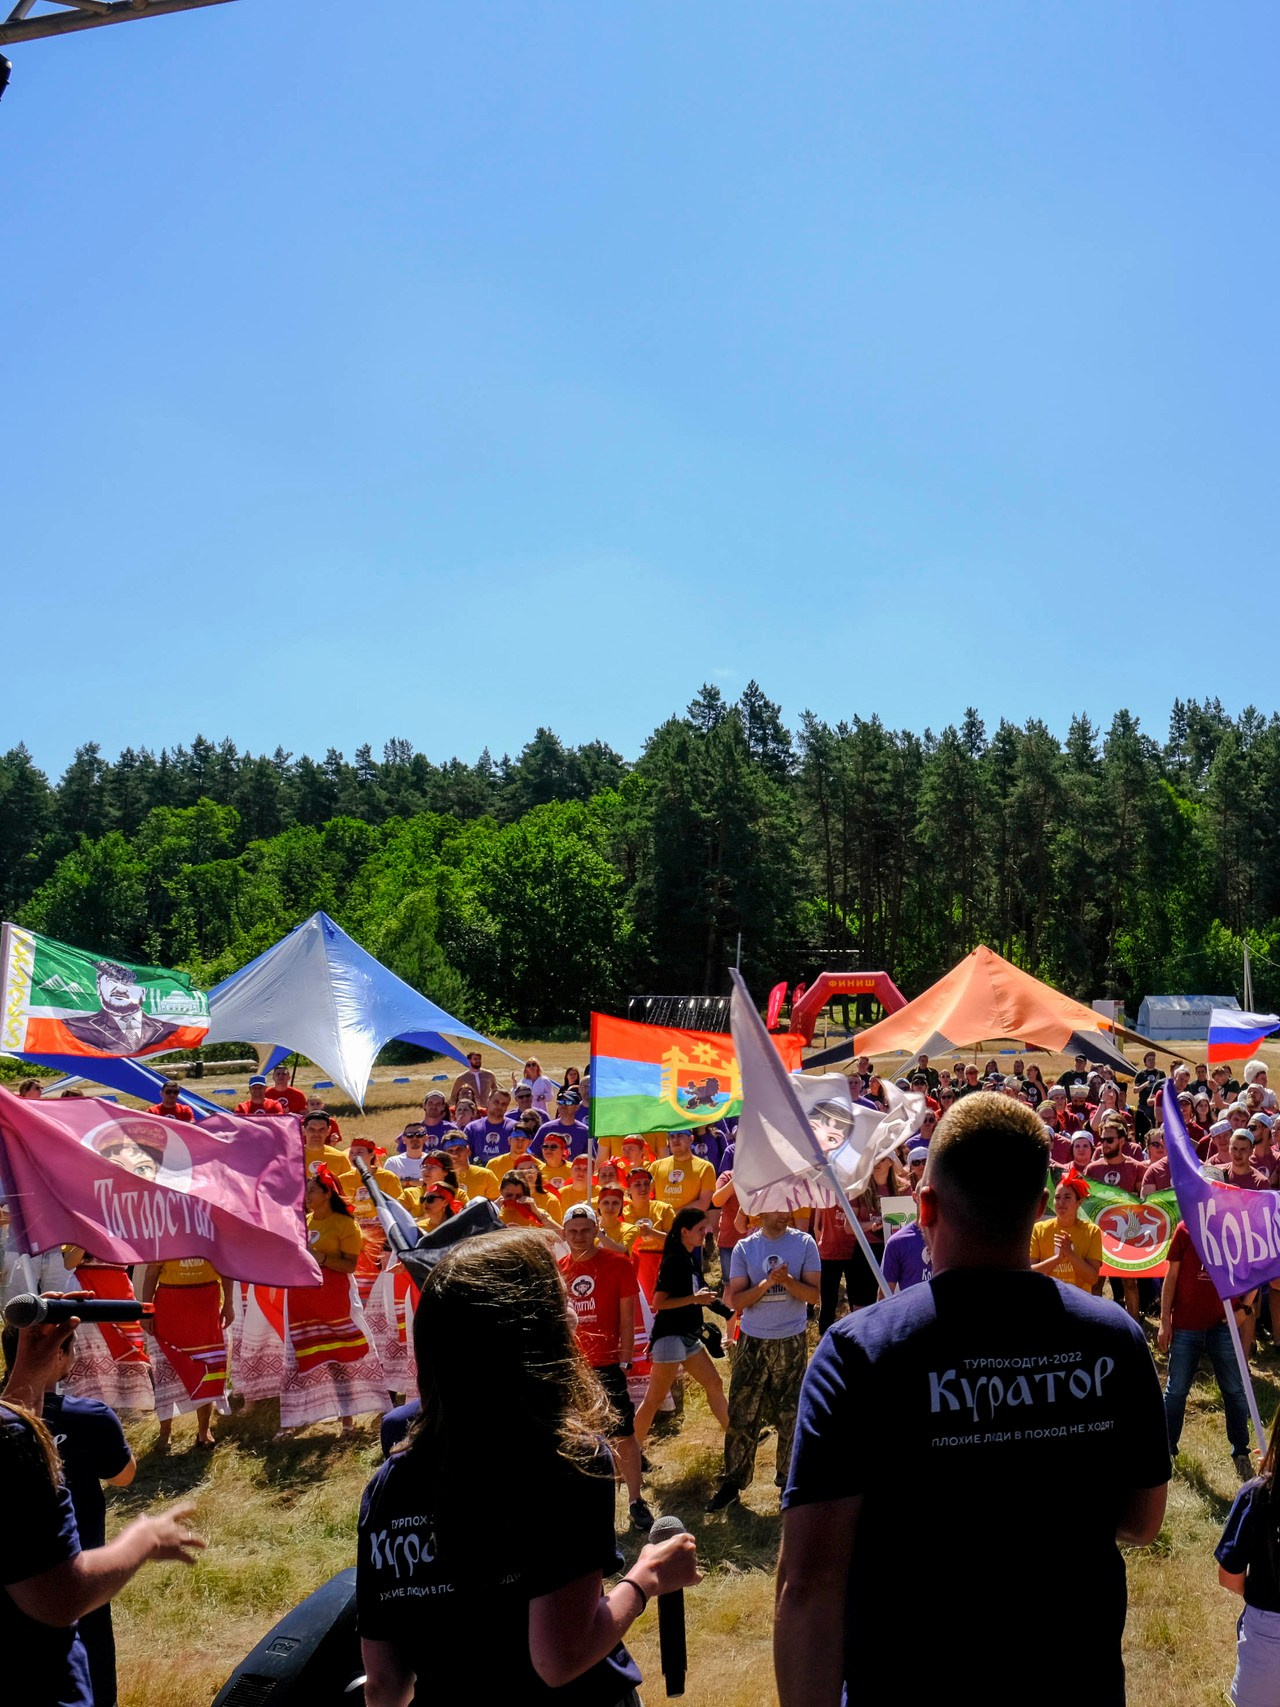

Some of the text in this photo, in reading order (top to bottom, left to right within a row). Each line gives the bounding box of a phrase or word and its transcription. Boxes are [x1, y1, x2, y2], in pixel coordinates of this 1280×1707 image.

[828, 979, 875, 988] ФИНИШ
[963, 1351, 1083, 1370] ТУРПОХОДГИ-2022
[928, 1356, 1115, 1423] Куратор
[931, 1433, 982, 1448] ПЛОХИЕ
[1014, 1430, 1022, 1440] В
[1024, 1425, 1068, 1440] ПОХОД
[1069, 1422, 1086, 1434] НЕ
